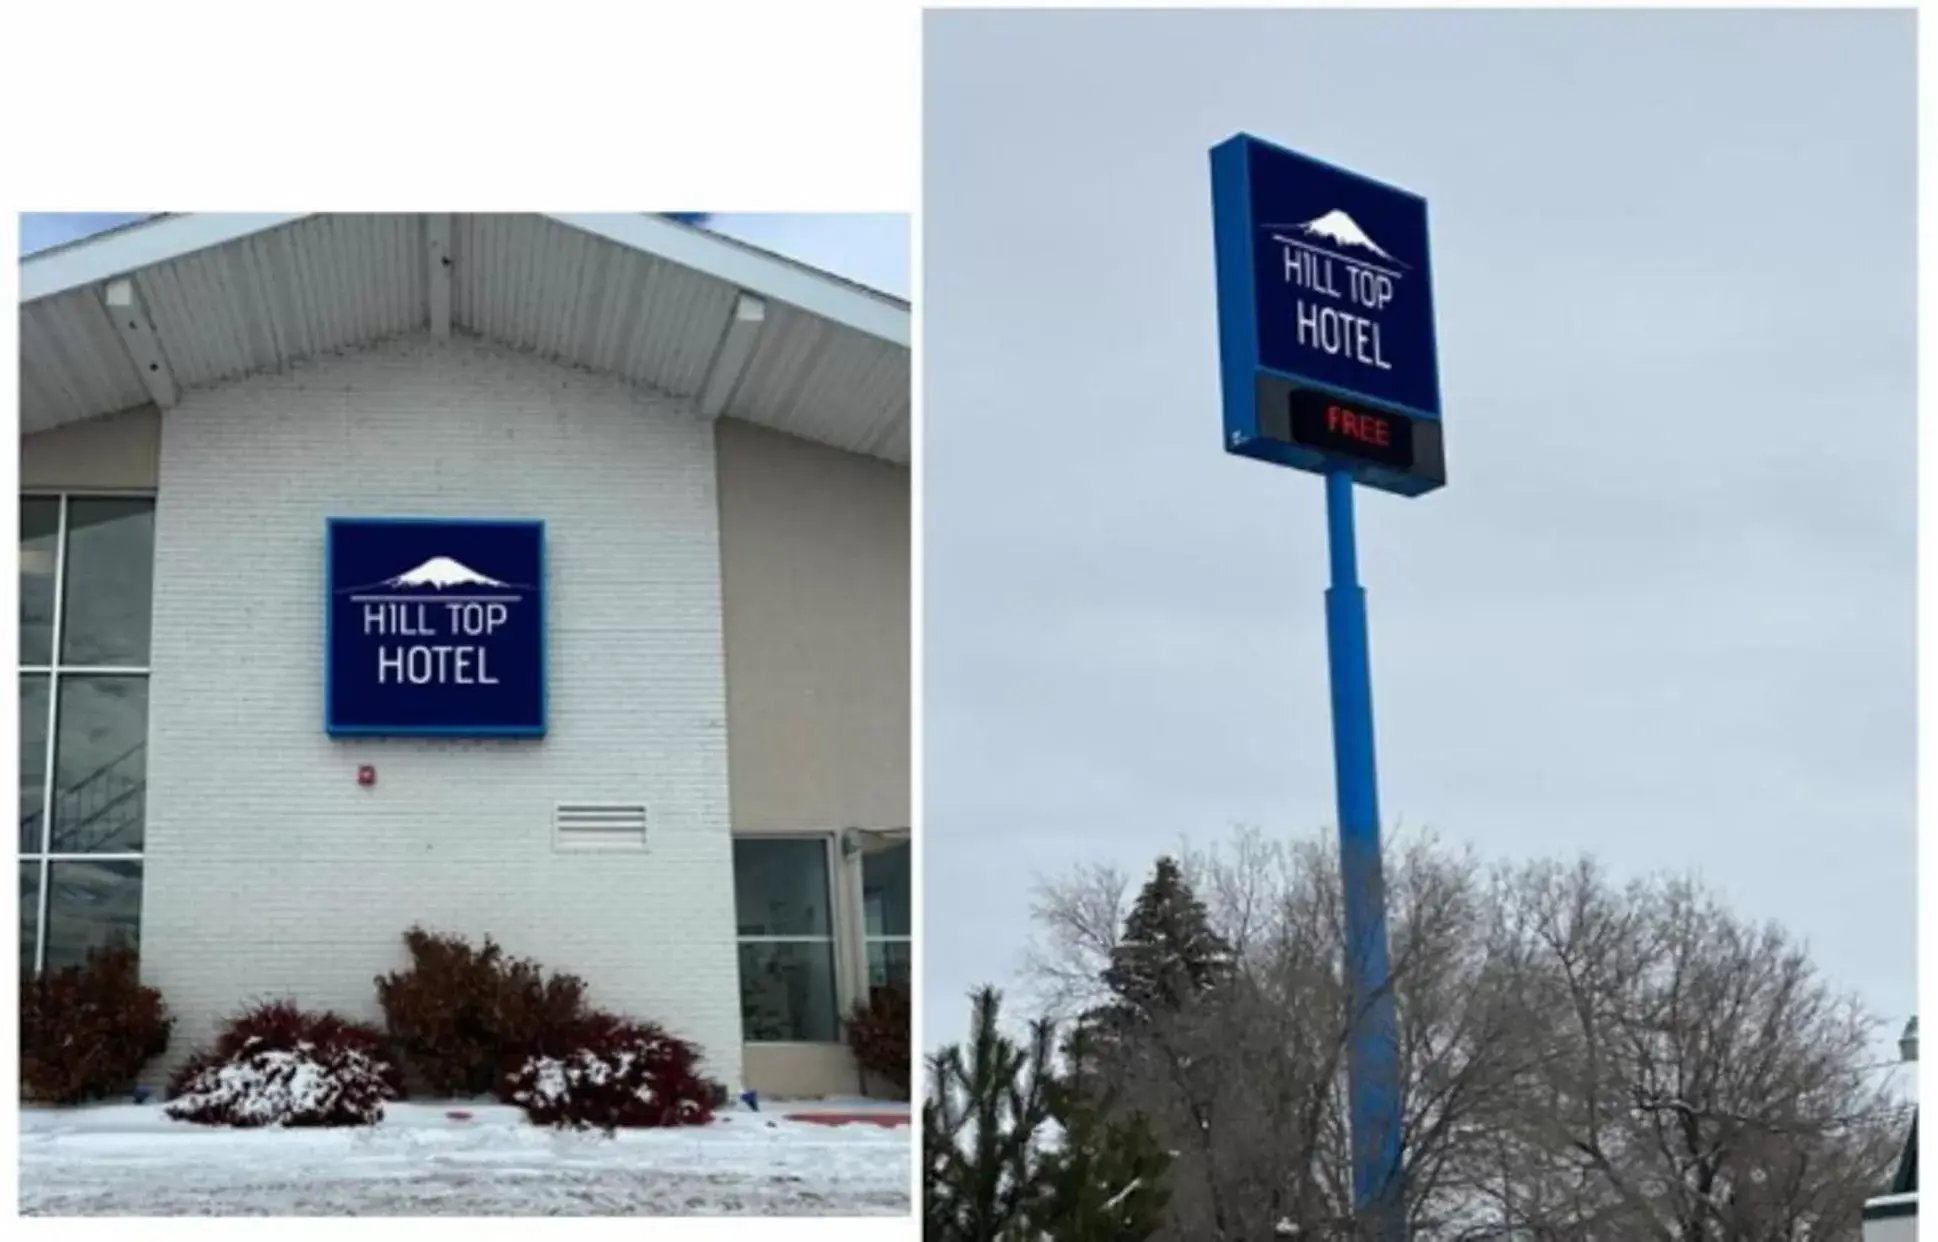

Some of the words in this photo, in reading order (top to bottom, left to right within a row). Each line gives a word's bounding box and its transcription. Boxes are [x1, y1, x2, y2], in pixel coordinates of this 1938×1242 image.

[1284, 245, 1341, 298] HILL
[1346, 264, 1393, 309] TOP
[1297, 300, 1392, 370] HOTEL
[1327, 406, 1391, 446] FREE
[364, 603, 435, 635] HILL
[446, 602, 507, 635] TOP
[378, 646, 499, 684] HOTEL
